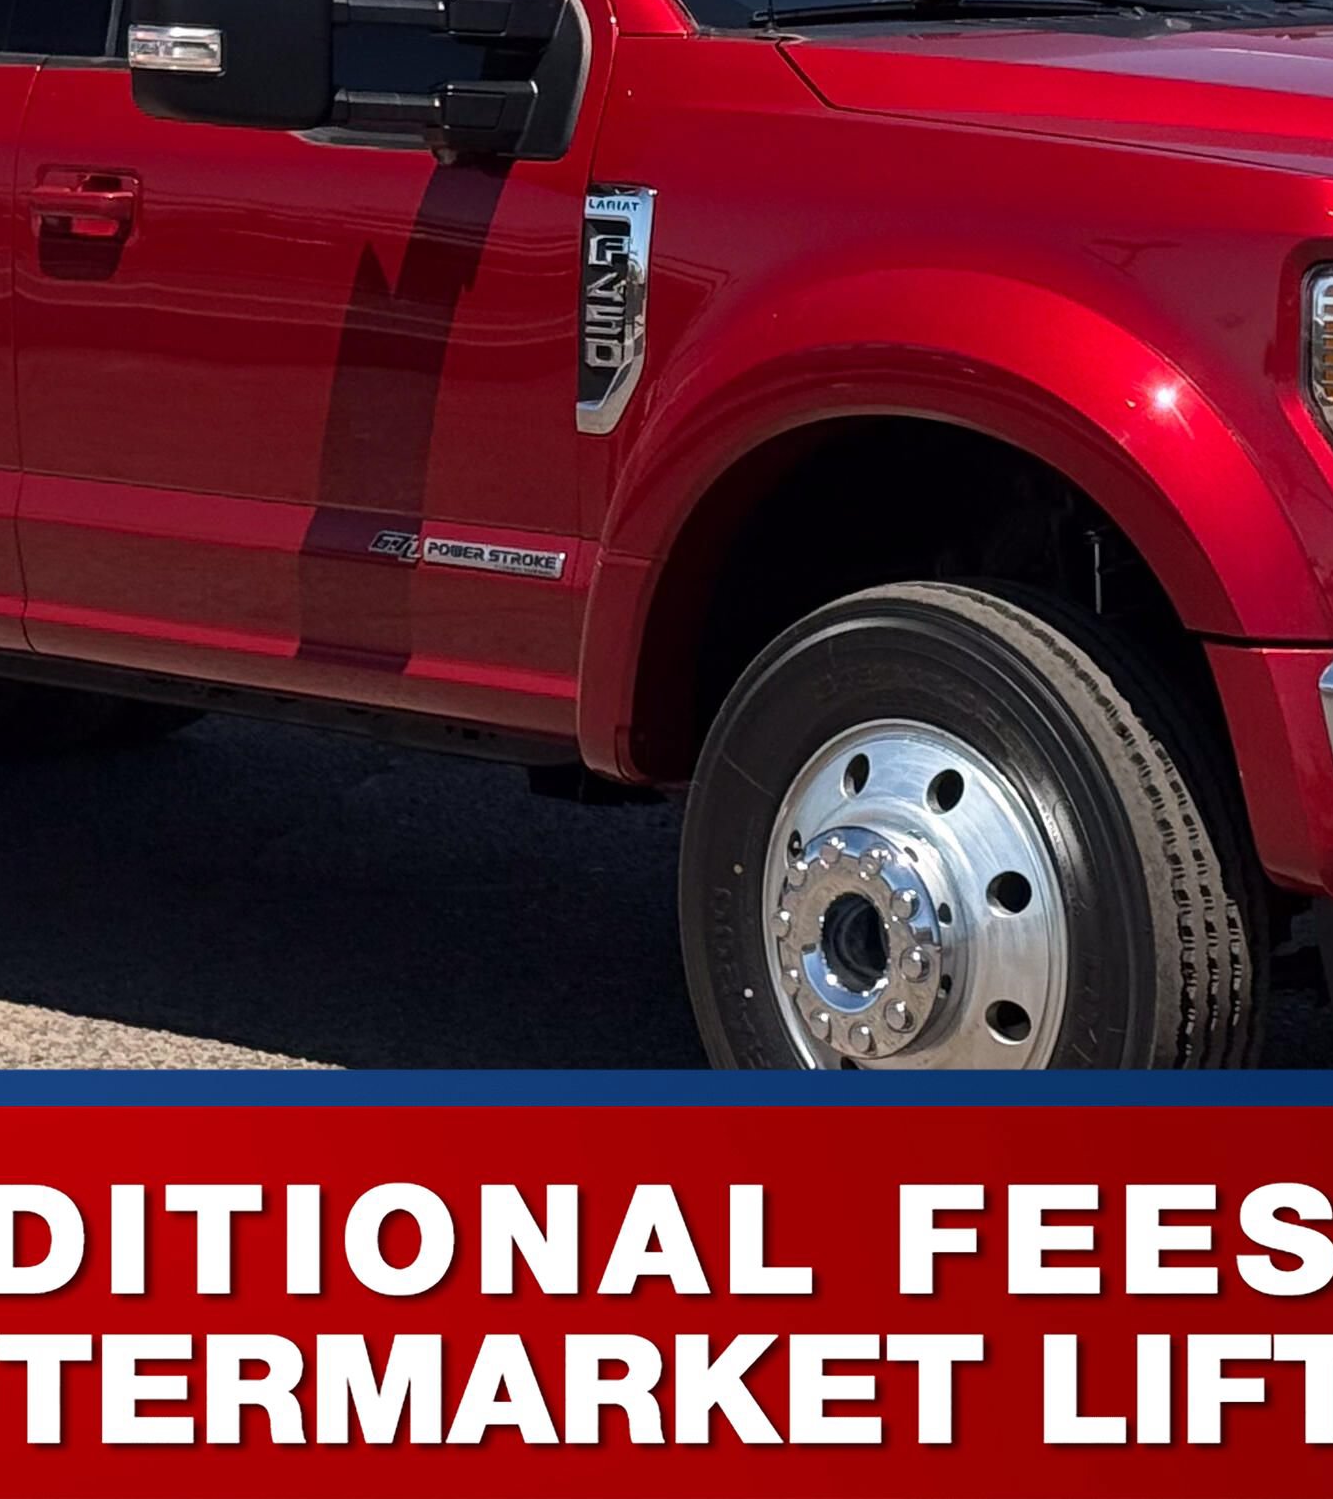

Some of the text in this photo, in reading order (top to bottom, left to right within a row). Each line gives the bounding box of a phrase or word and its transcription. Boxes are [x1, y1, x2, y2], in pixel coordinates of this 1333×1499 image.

[587, 198, 642, 213] LARIAT
[428, 541, 485, 561] POWER
[488, 548, 557, 570] STROKE
